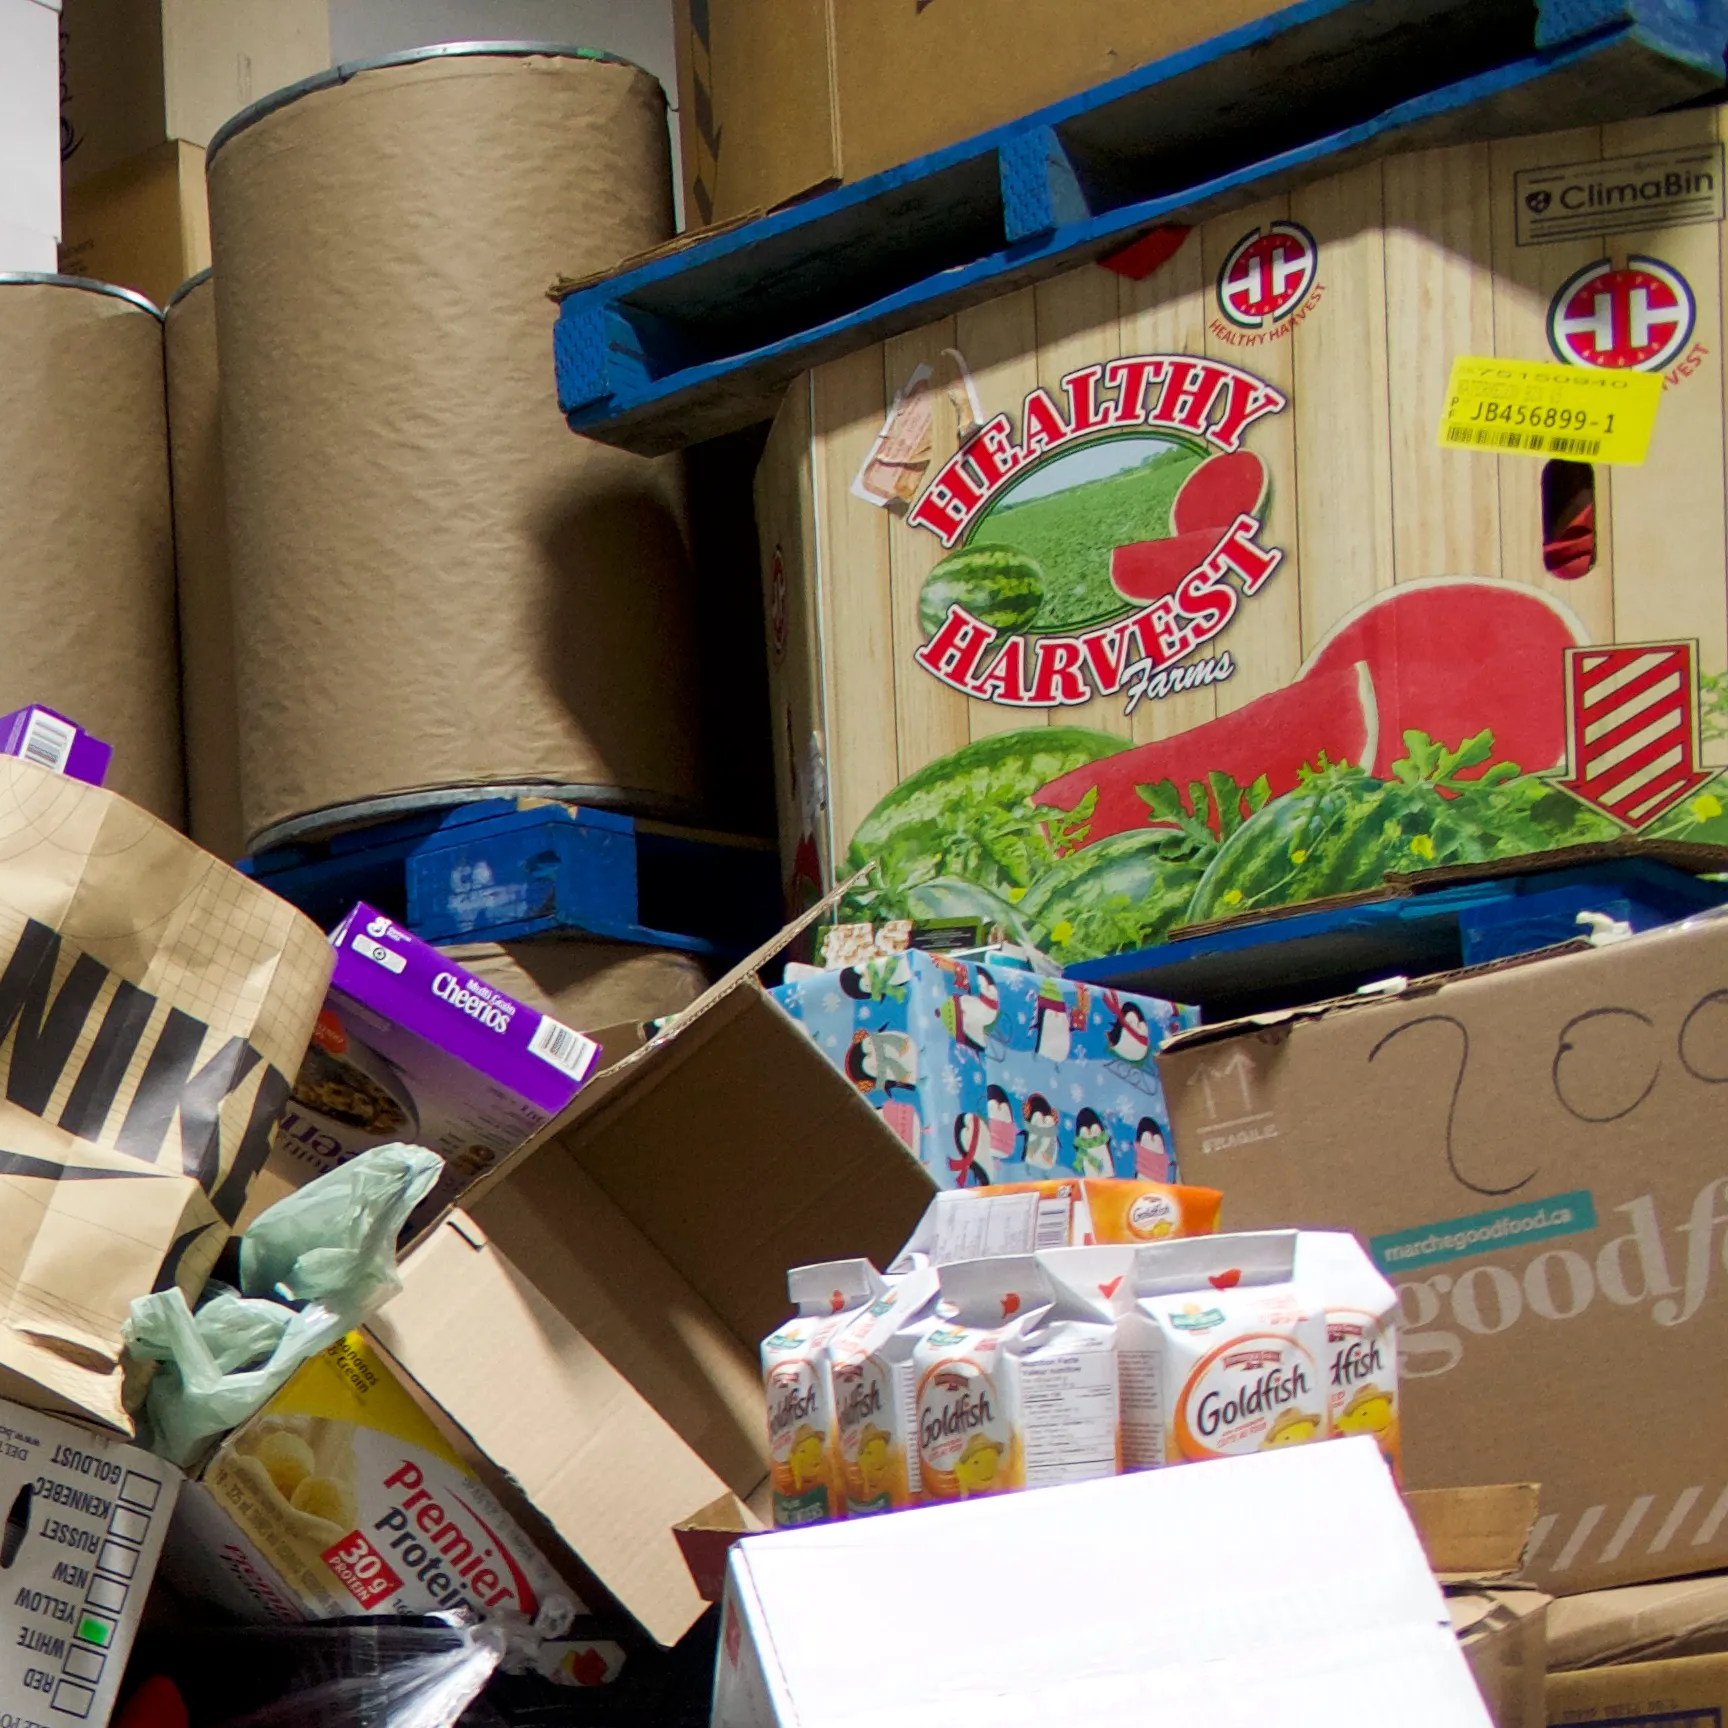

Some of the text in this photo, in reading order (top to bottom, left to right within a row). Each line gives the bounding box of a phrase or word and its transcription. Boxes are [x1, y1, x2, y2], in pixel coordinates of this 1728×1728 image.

[1560, 169, 1714, 210] ClimaBin
[1207, 281, 1326, 347] HEALTHY HARVEST
[1470, 401, 1615, 434] JB456899-1
[907, 354, 1286, 548] HEALTHY
[916, 515, 1283, 707] HARVEST
[1121, 651, 1235, 715] Farms
[432, 972, 511, 1034] Cheerios
[466, 979, 516, 1015] Multi Grain
[1384, 1207, 1573, 1262] marchegoodfood.ca
[920, 1390, 995, 1449] Goldfish
[1197, 1364, 1310, 1436] Goldfish
[51, 1444, 121, 1484] GOLDUST
[32, 1477, 113, 1519] KENNEBEC
[40, 1518, 100, 1554] RUSSET
[384, 1460, 514, 1607] Premier
[53, 1562, 88, 1589] NEW
[329, 1555, 371, 1600] PROTEIN
[15, 1588, 76, 1623] YELLOW
[17, 1626, 65, 1659] WHITE
[24, 1668, 55, 1693] RED
